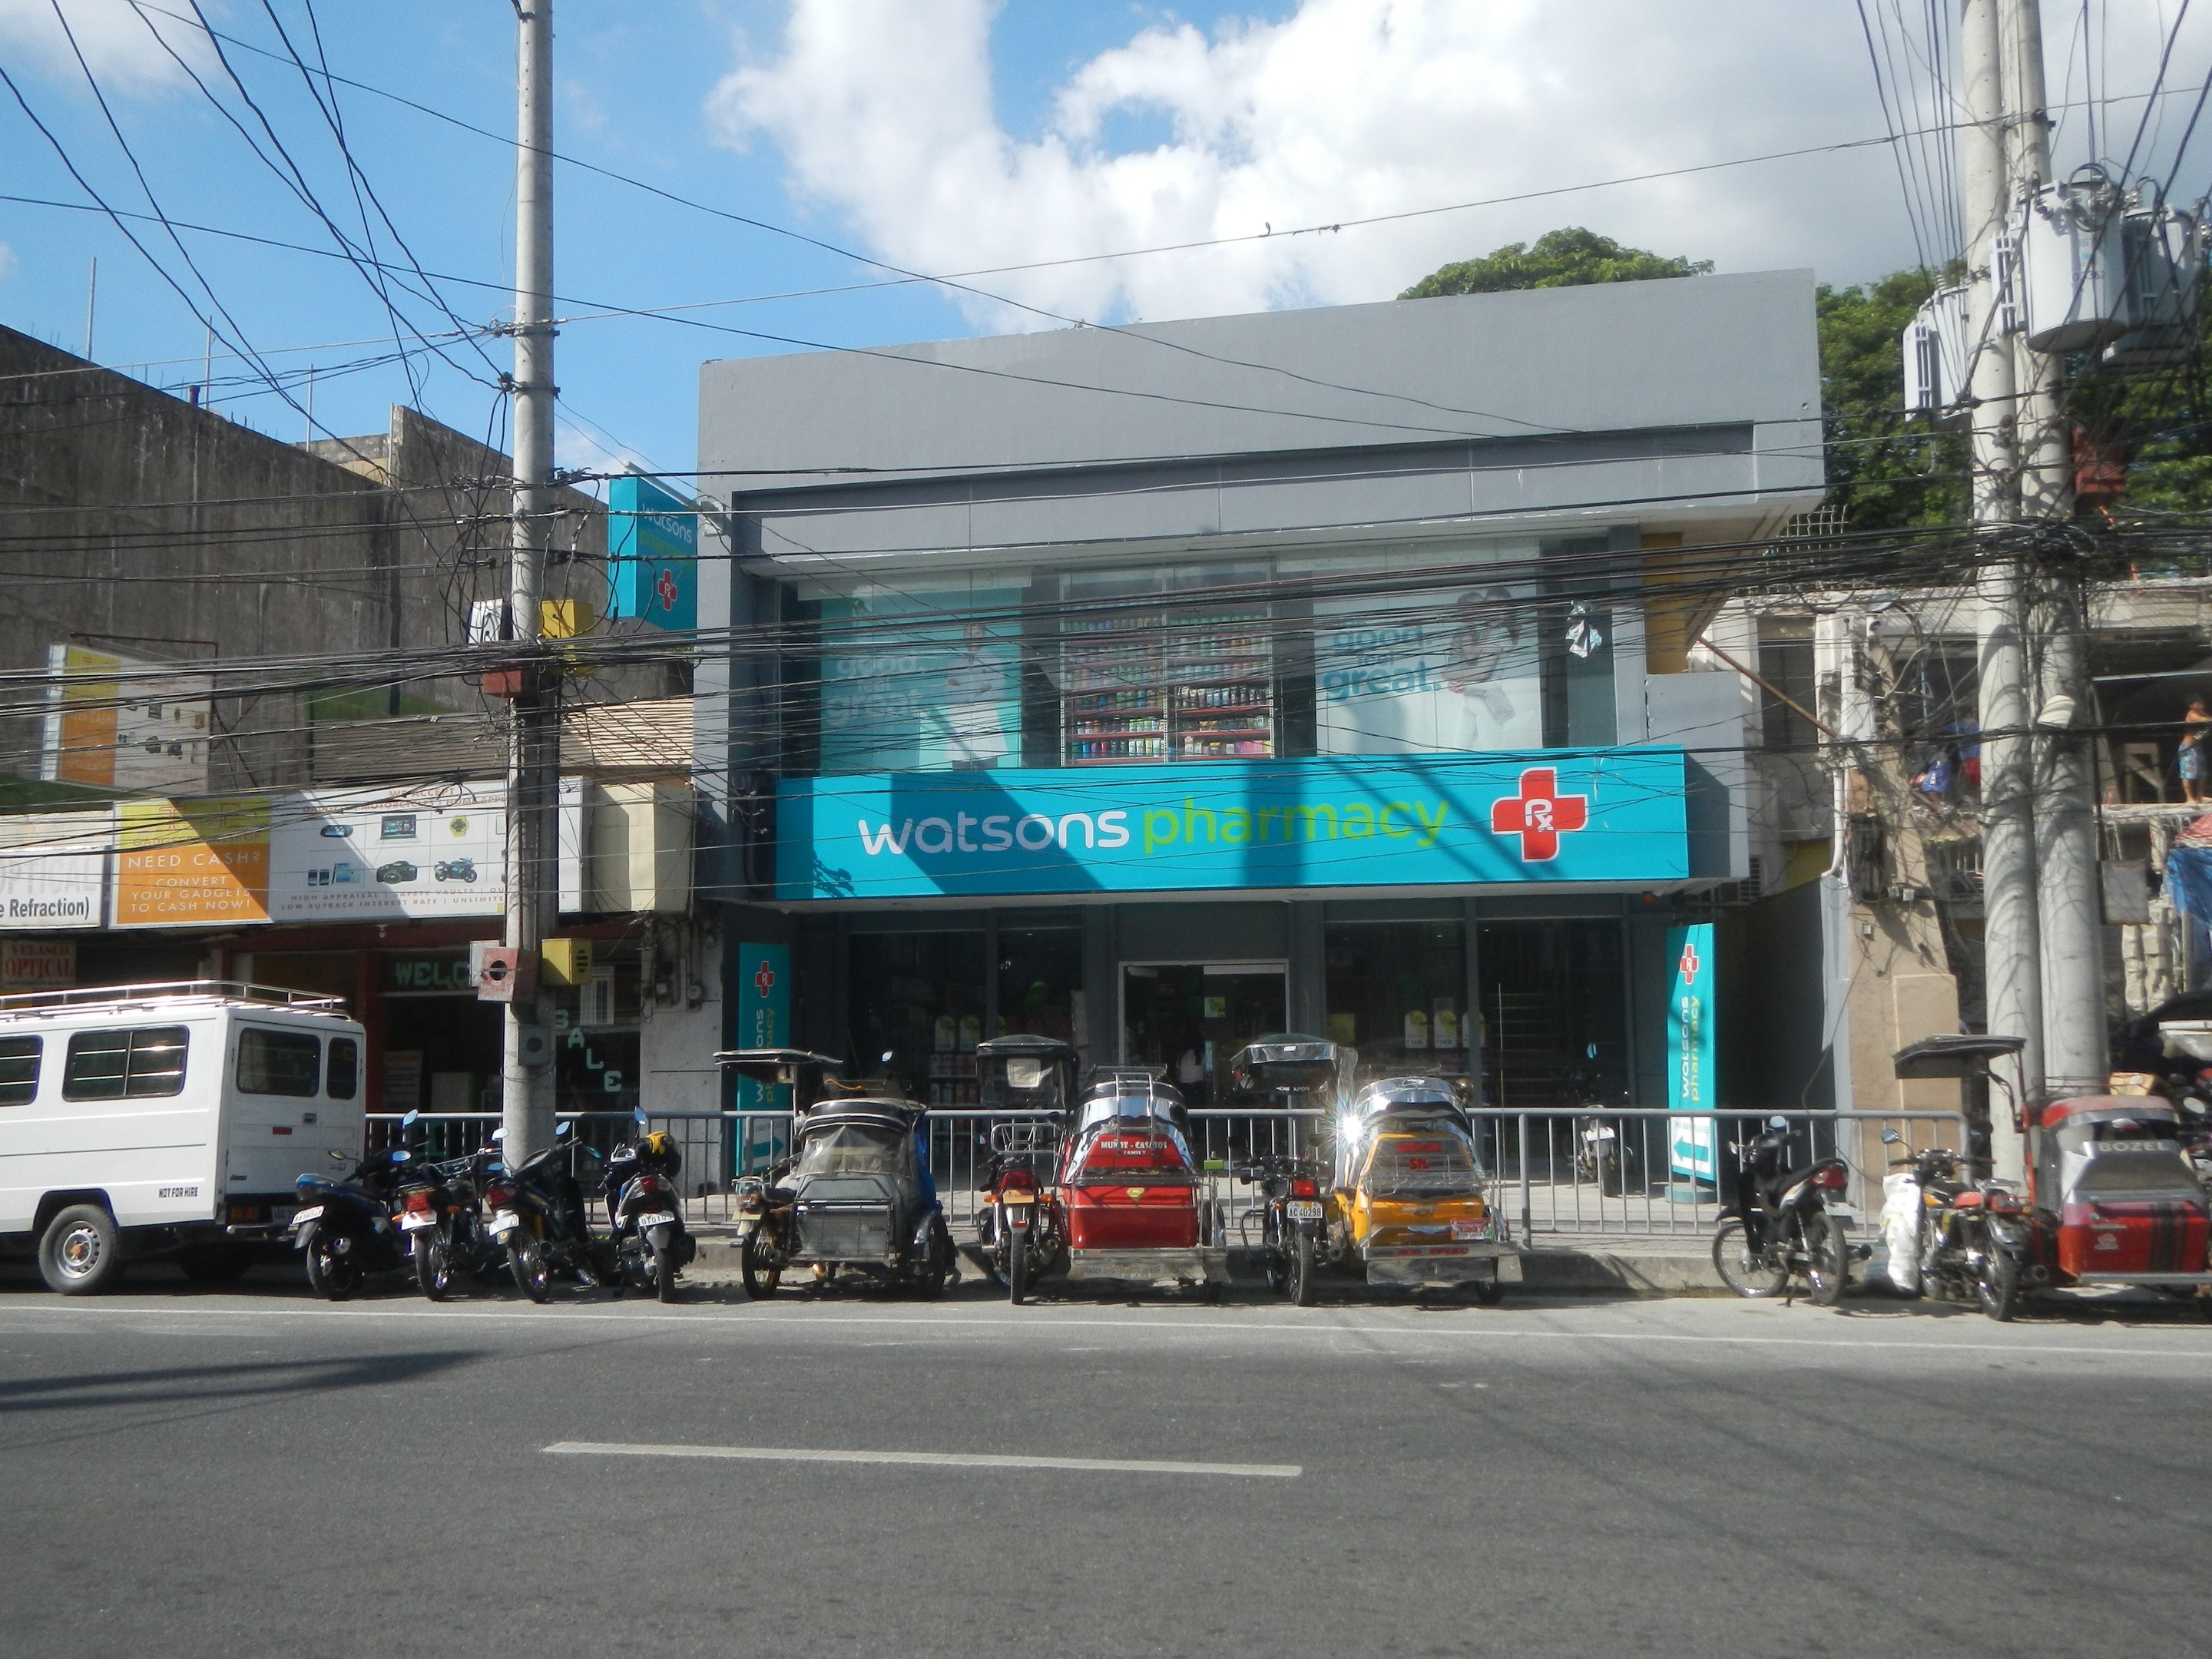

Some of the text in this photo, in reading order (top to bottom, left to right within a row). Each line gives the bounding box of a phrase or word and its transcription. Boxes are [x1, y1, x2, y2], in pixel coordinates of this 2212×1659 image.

[642, 503, 693, 544] watsons
[1323, 661, 1442, 703] great.
[858, 796, 1450, 855] watsons pharmacy
[128, 851, 261, 869] NEED CASH?
[156, 876, 228, 887] CONVERT
[132, 888, 250, 901] YOUR GADGETS
[308, 902, 354, 910] BUYBACK
[453, 896, 504, 904] UNLIMITE
[323, 892, 378, 900] APPRAISAL
[9, 896, 89, 920] Refraction)
[131, 899, 250, 913] TO CASH NOW!
[5, 959, 74, 978] OPTICAL
[396, 962, 470, 987] WELC
[1681, 995, 1690, 1098] watsons
[1690, 995, 1700, 1102] pharmacy
[2098, 1141, 2169, 1151] BOZEL
[158, 1187, 198, 1198] NOT FOR HIRE
